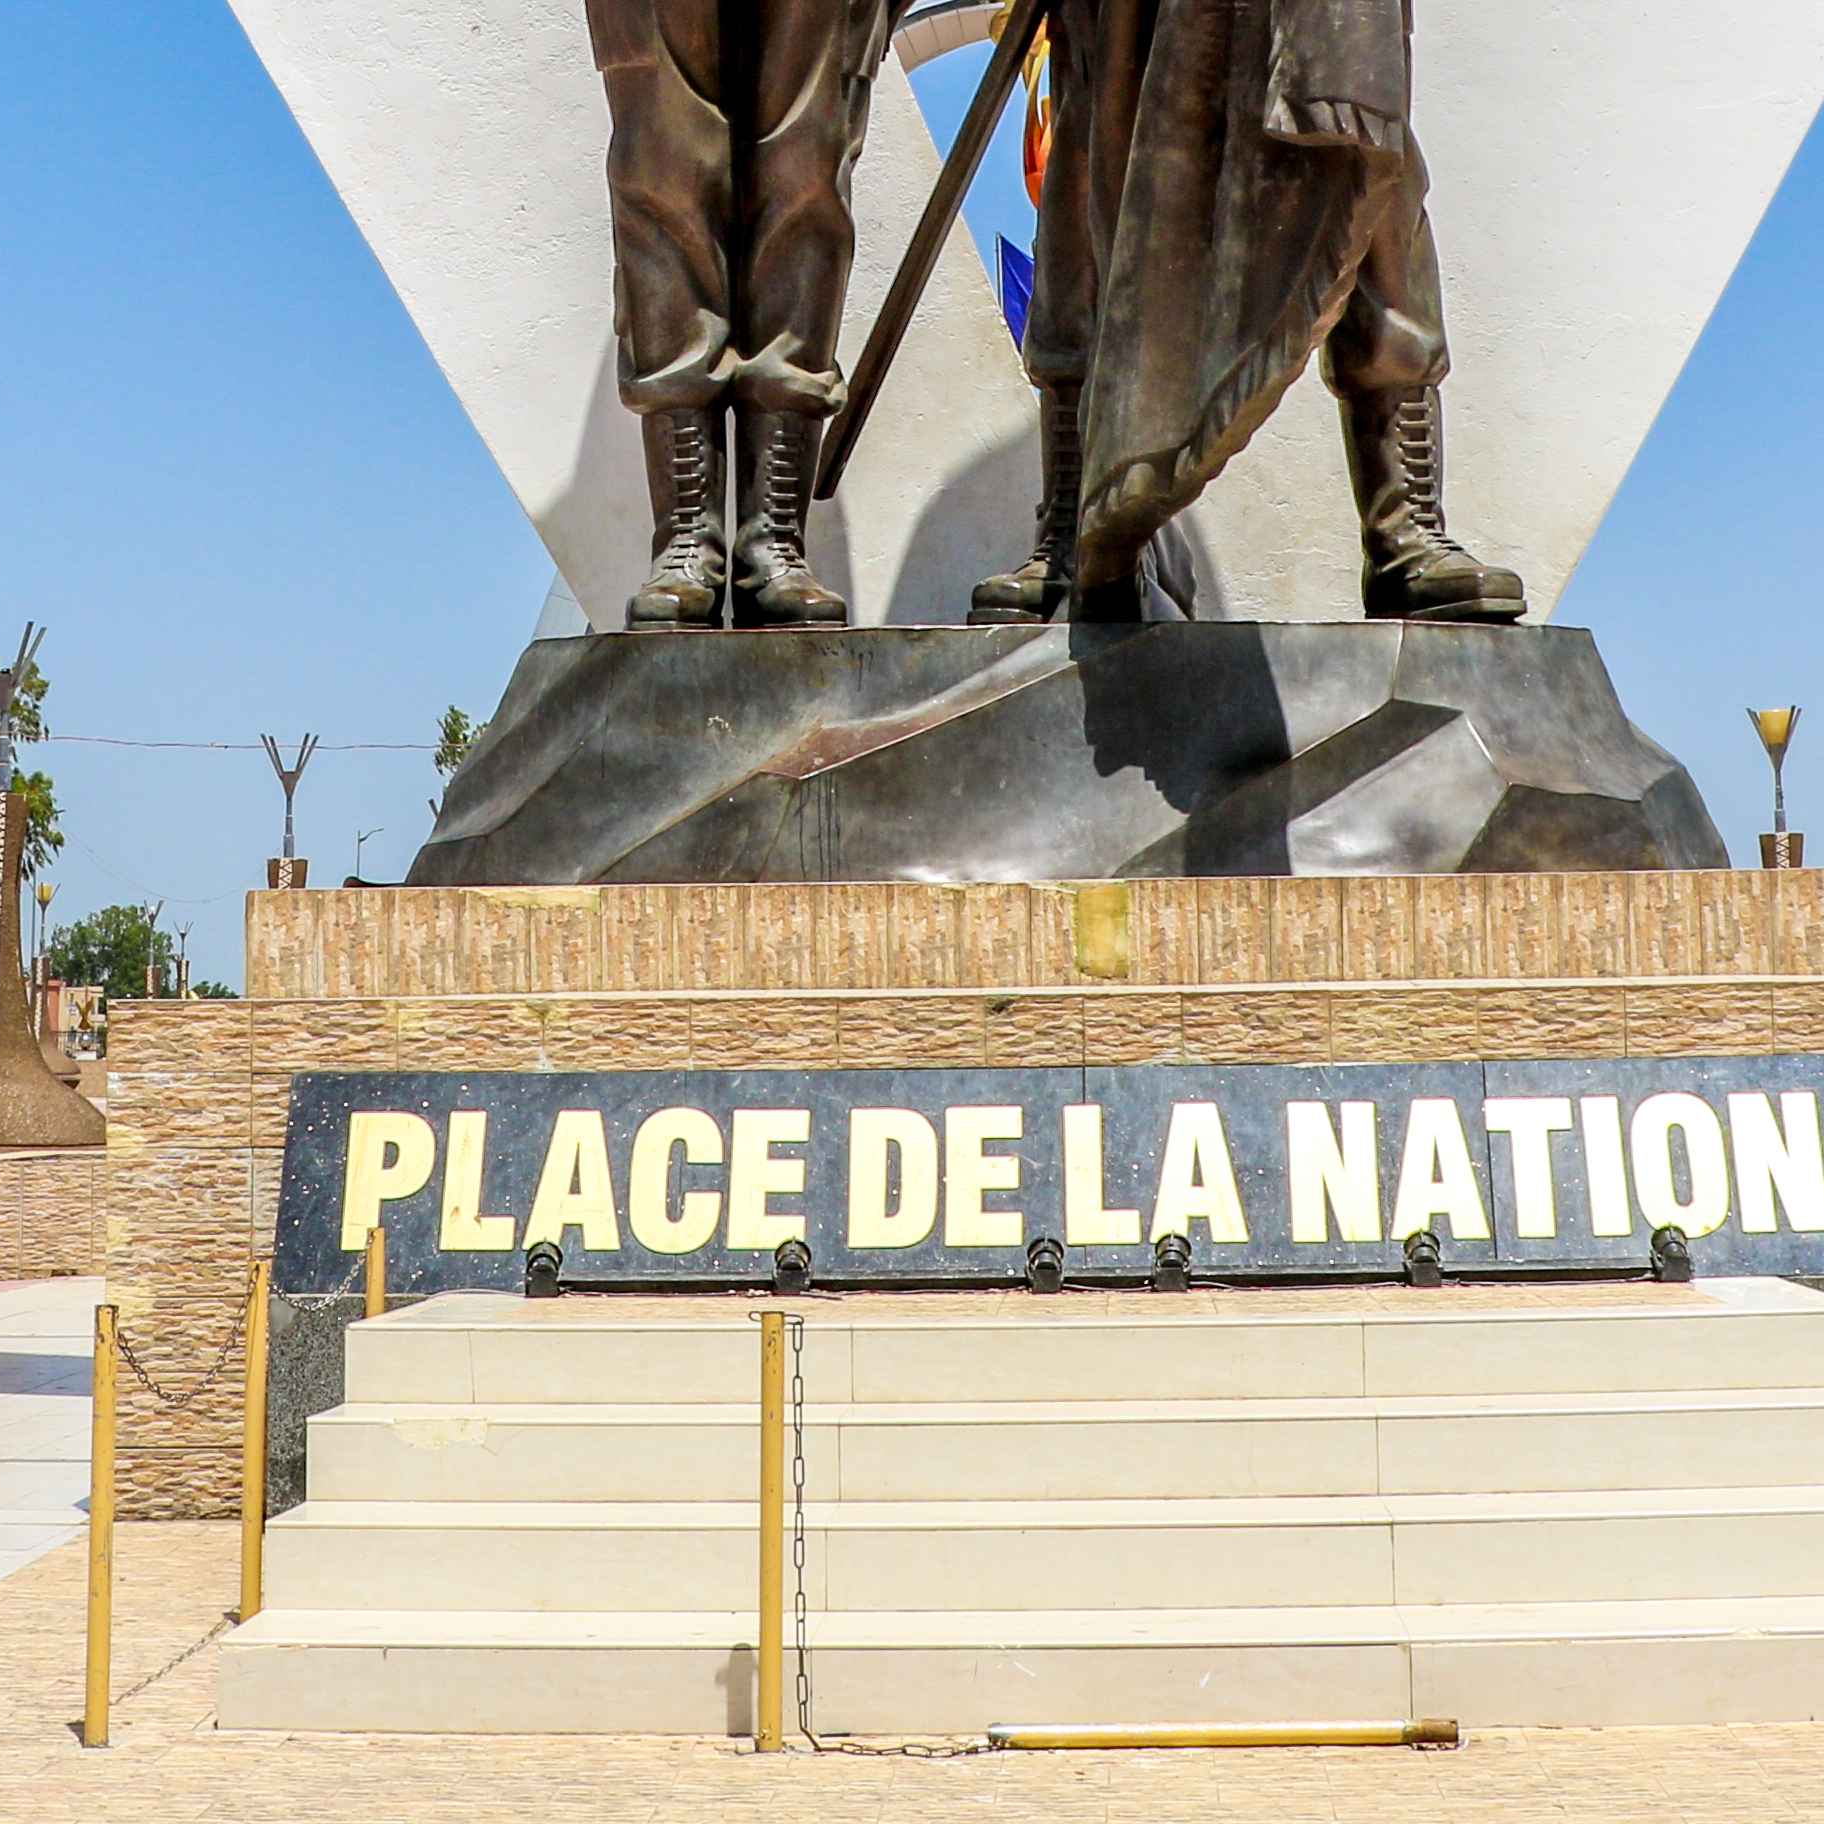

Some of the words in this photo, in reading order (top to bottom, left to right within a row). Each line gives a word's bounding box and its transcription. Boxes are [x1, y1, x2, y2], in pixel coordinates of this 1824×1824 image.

[340, 1107, 811, 1255] PLACE
[847, 1104, 1024, 1249] DE
[1062, 1101, 1250, 1246] LA
